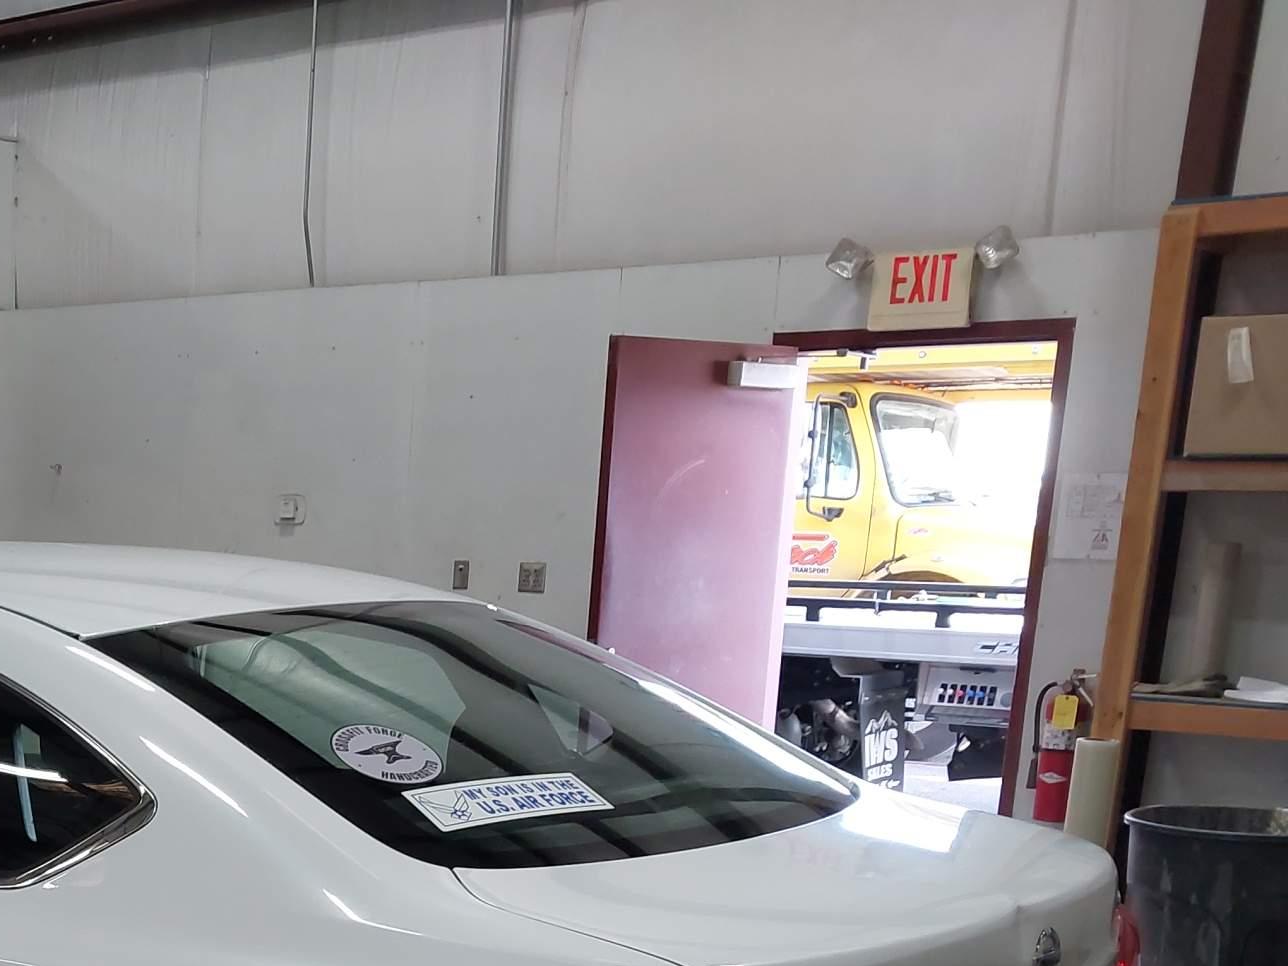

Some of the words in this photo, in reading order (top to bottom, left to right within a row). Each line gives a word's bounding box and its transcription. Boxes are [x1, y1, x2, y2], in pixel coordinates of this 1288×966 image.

[889, 253, 958, 305] EXIT
[791, 566, 830, 575] TRANSPORT
[463, 788, 486, 801] MY
[487, 784, 519, 798] SON
[515, 782, 534, 794] IS
[531, 781, 553, 792] IN
[548, 779, 580, 791] THE
[476, 799, 515, 815] U.S.
[512, 795, 545, 810] AIR
[539, 790, 596, 807] FORCE
